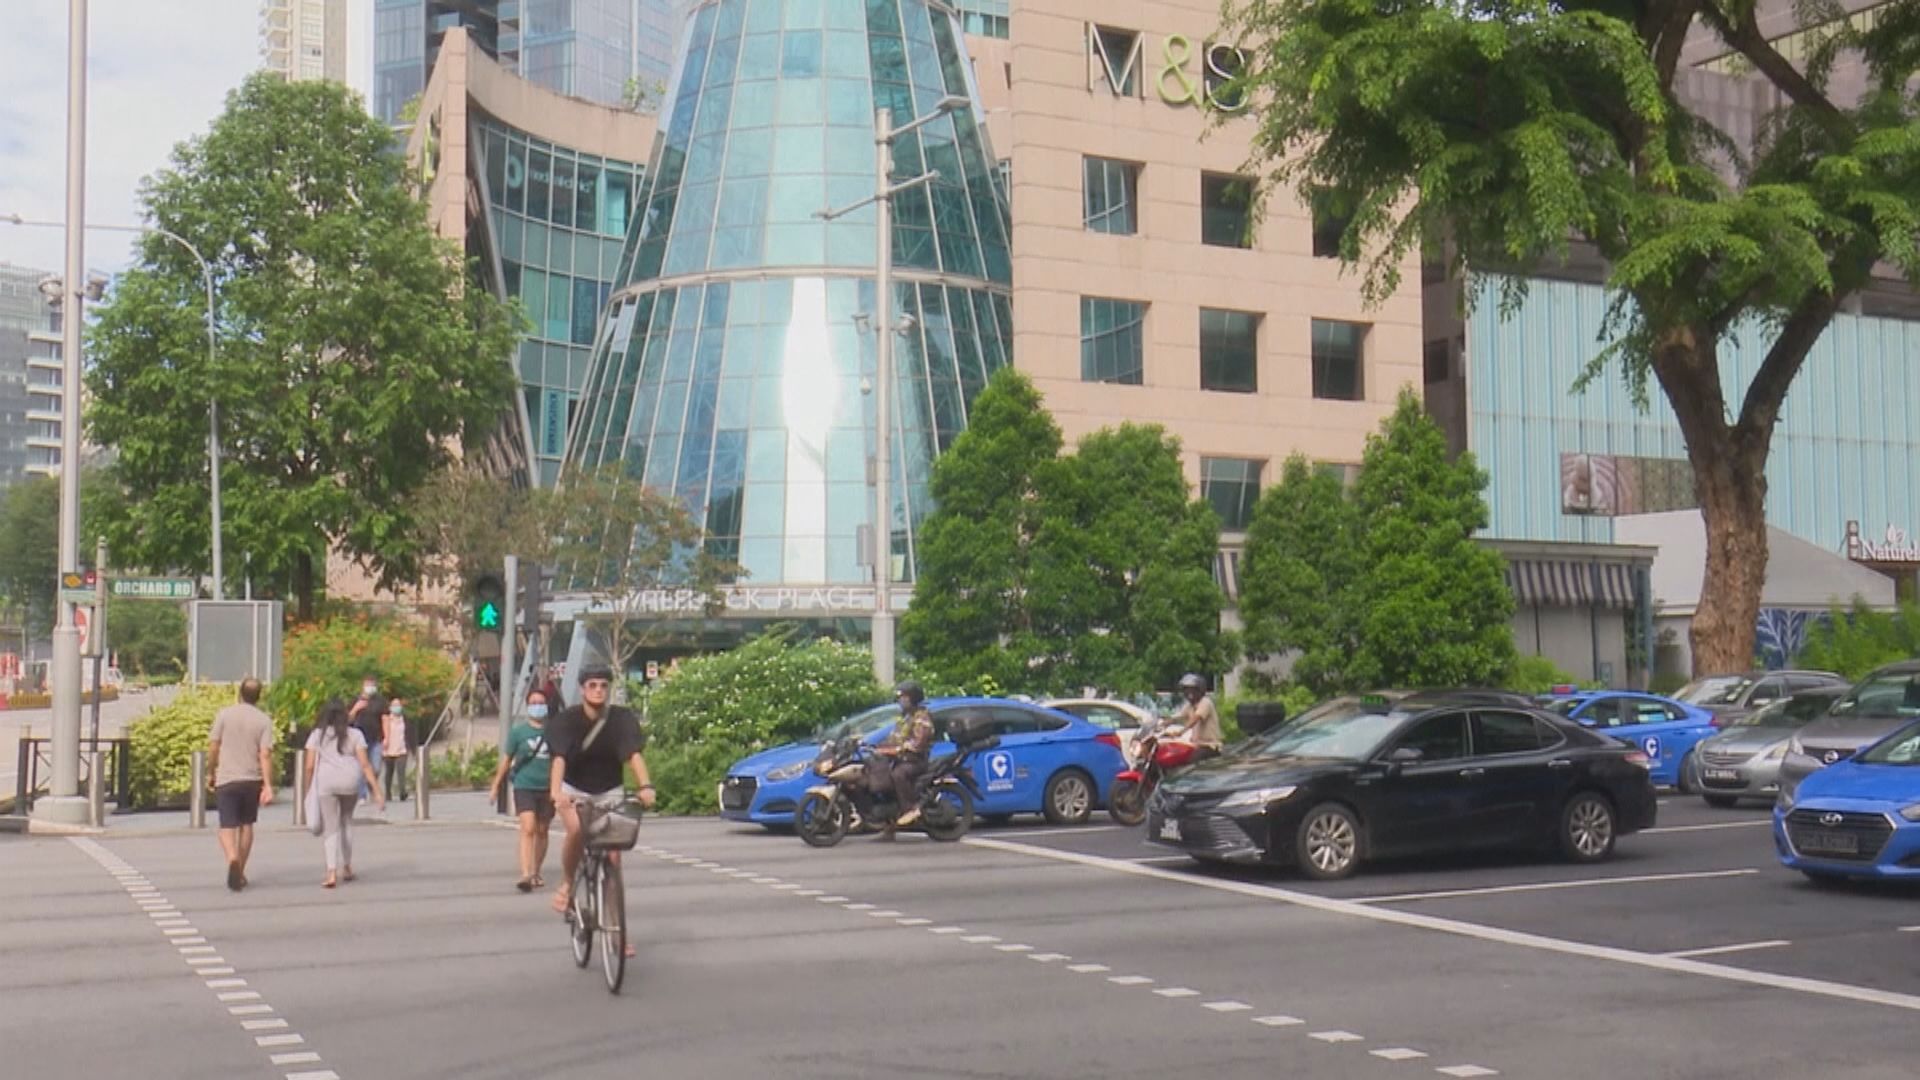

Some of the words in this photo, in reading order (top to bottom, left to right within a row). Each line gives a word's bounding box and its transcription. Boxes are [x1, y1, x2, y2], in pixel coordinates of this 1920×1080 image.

[1085, 21, 1249, 112] M&S
[114, 580, 171, 596] ORCHARD
[173, 581, 191, 596] RD
[776, 587, 867, 609] PLACE
